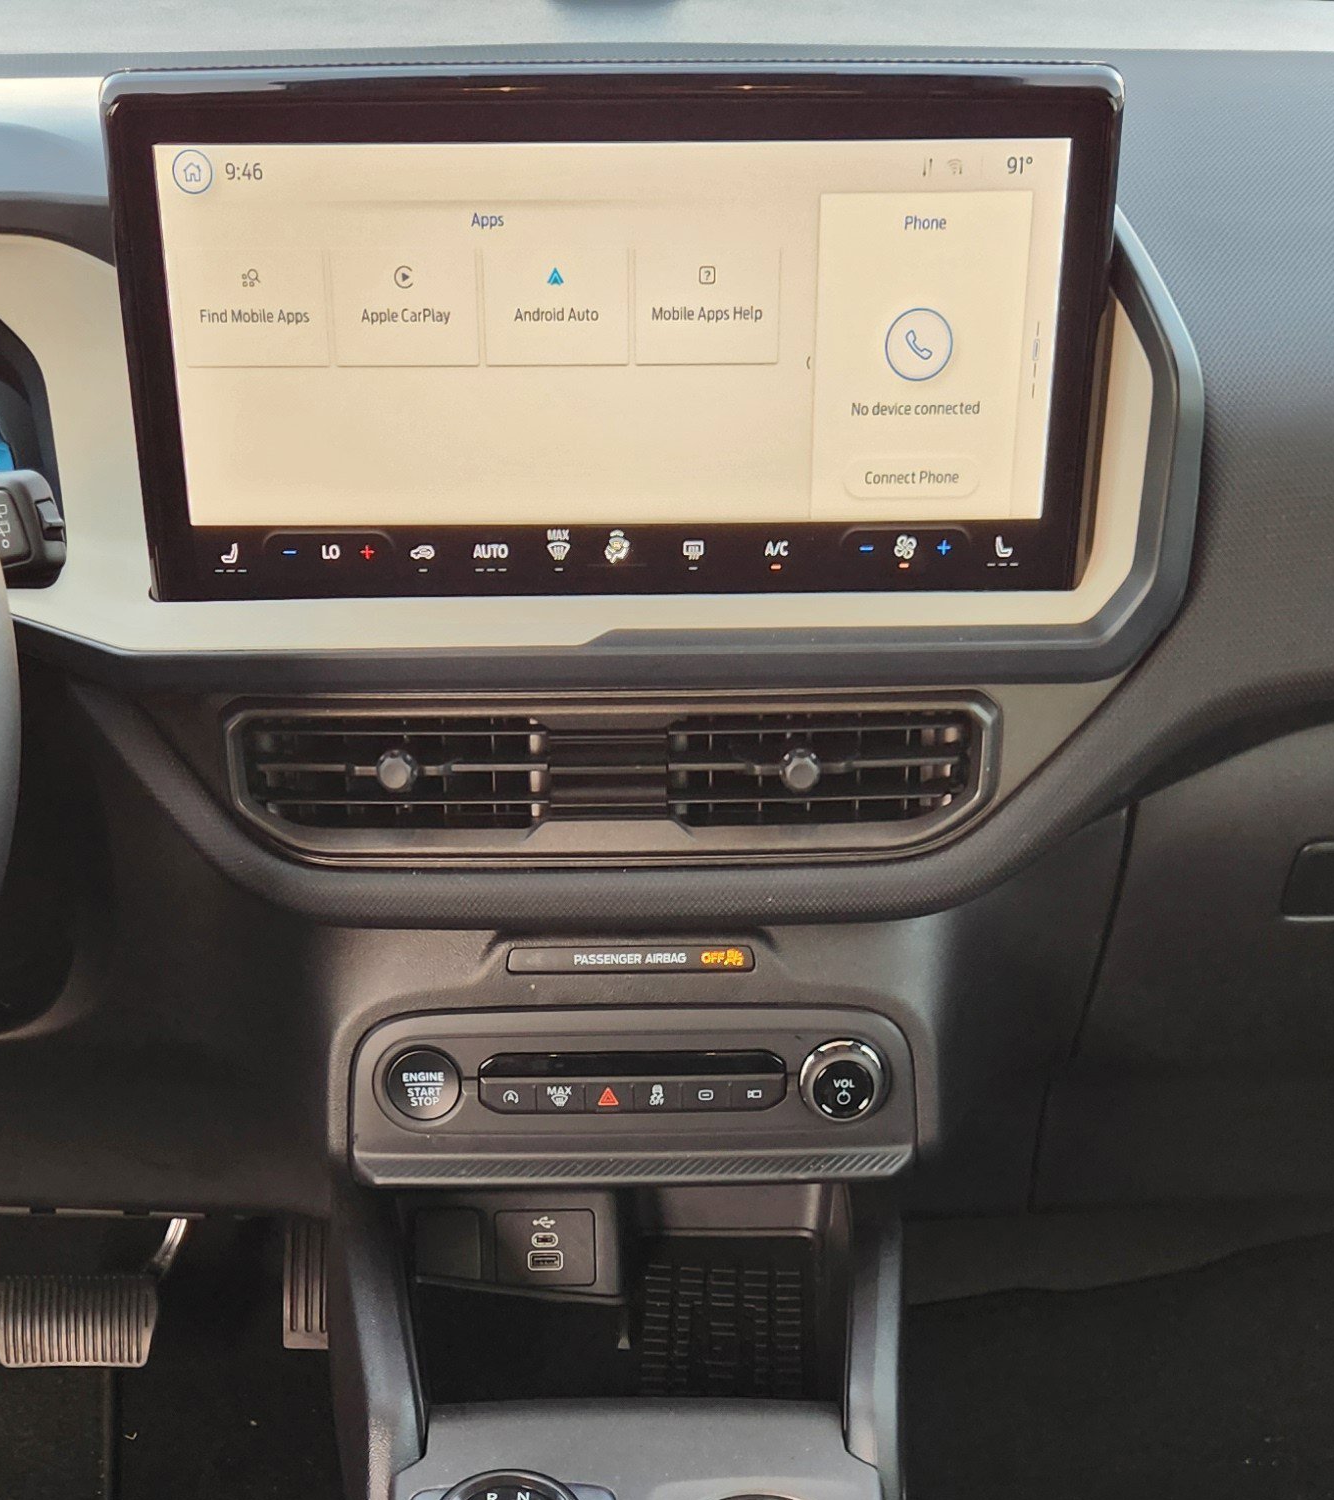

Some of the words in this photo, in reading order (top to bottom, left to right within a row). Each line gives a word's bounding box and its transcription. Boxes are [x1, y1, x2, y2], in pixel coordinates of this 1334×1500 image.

[225, 162, 264, 182] 9:46
[1006, 156, 1034, 175] 91°
[470, 211, 505, 229] Apps
[903, 215, 947, 232] Phone
[199, 308, 228, 324] Find
[230, 307, 275, 324] Mobile
[276, 308, 311, 326] Apps
[360, 307, 399, 326] Apple
[400, 307, 451, 326] CarPlay
[513, 306, 564, 322] Android
[567, 306, 600, 322] Auto
[650, 305, 695, 322] Mobile
[697, 306, 731, 324] Apps
[733, 305, 763, 323] Help
[851, 402, 868, 416] No
[872, 401, 912, 416] device
[914, 401, 981, 416] connected
[864, 470, 917, 485] Connect
[919, 470, 959, 485] Phone
[546, 529, 570, 542] MAX
[321, 544, 341, 561] LO
[472, 543, 509, 560] AUTO
[764, 540, 789, 557] A/C
[573, 953, 642, 965] PASSENGER
[644, 952, 687, 965] AIRBAG
[700, 949, 725, 965] OFF
[401, 1071, 445, 1083] ENGINE
[832, 1078, 856, 1089] VOL
[407, 1086, 442, 1098] START
[546, 1085, 573, 1096] MAX
[410, 1096, 440, 1107] STOP
[649, 1098, 665, 1107] OFF
